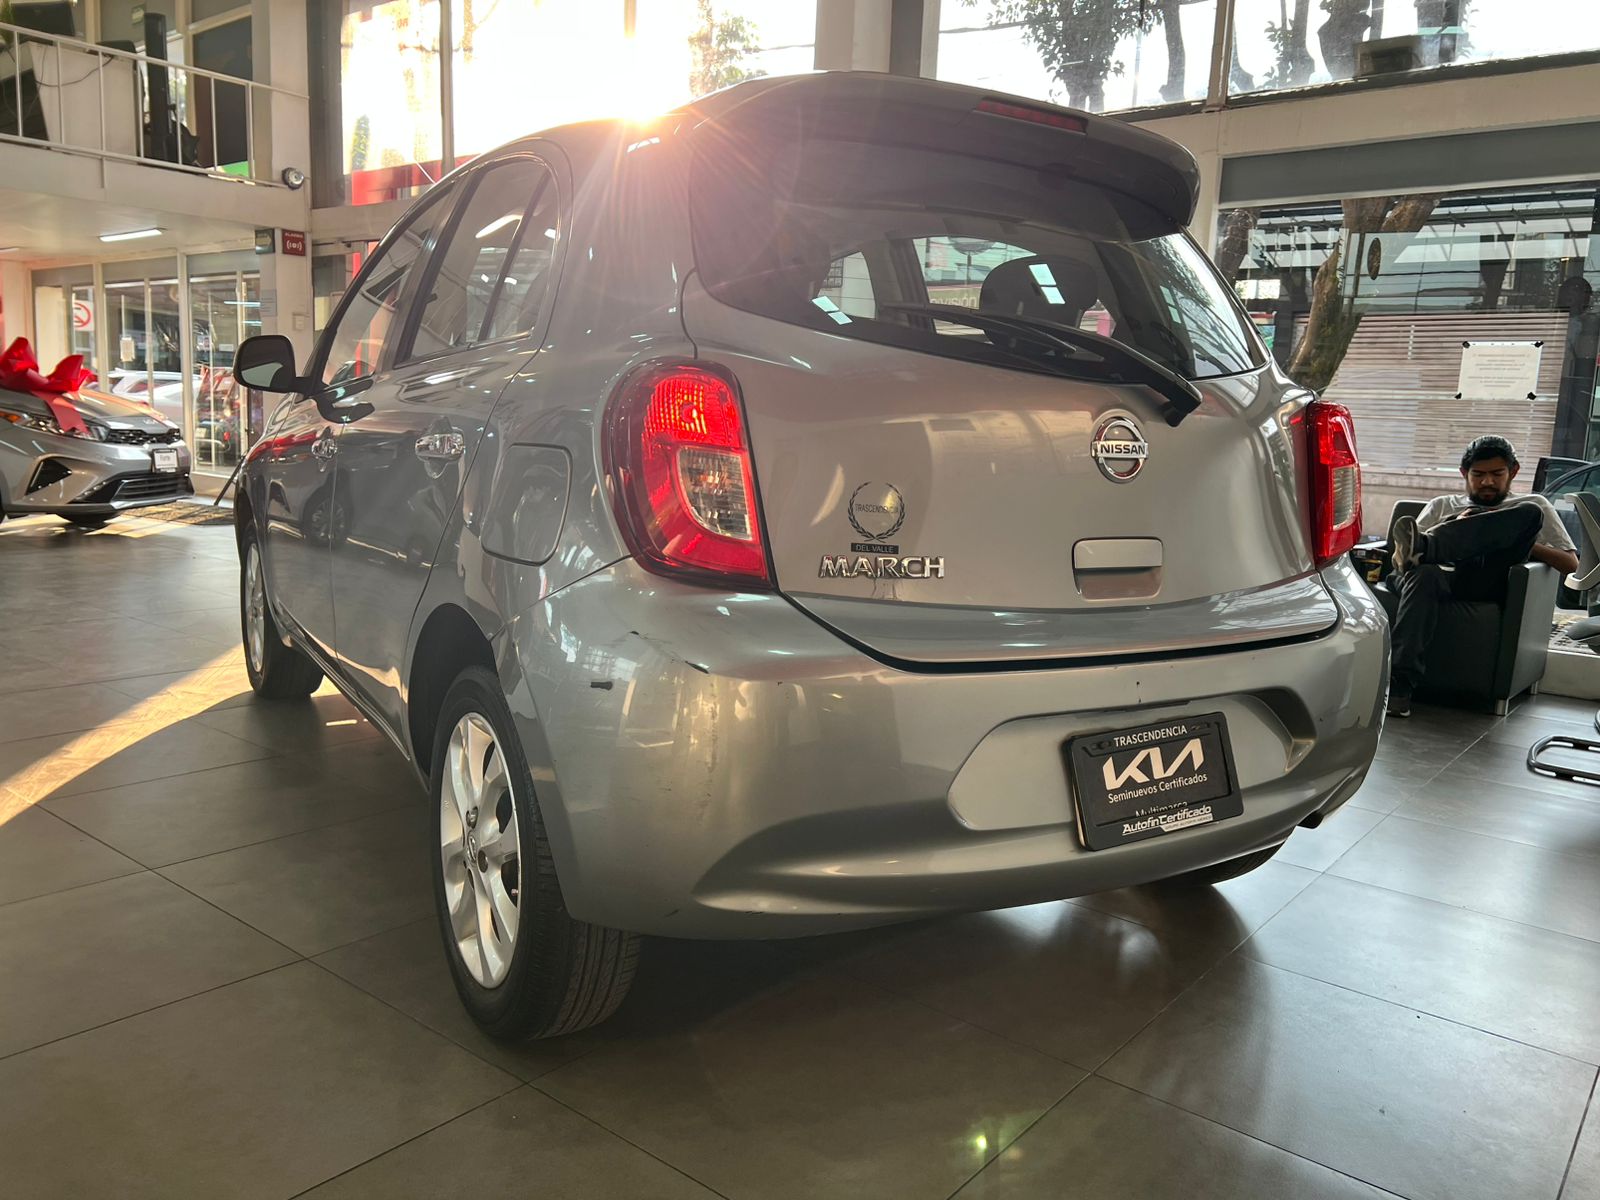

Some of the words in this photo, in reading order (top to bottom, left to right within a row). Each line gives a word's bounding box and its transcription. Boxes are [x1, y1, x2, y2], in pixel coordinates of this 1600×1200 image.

[1100, 444, 1145, 454] NISSAN
[855, 503, 899, 514] TRASCENDE
[856, 544, 869, 552] DEL
[872, 545, 894, 553] VALLE
[819, 555, 945, 579] MARCH
[1114, 725, 1187, 747] TRASCENDENCIA
[1102, 738, 1204, 790] KIA
[1108, 786, 1158, 804] Seminuevos
[1159, 773, 1208, 792] Certificados
